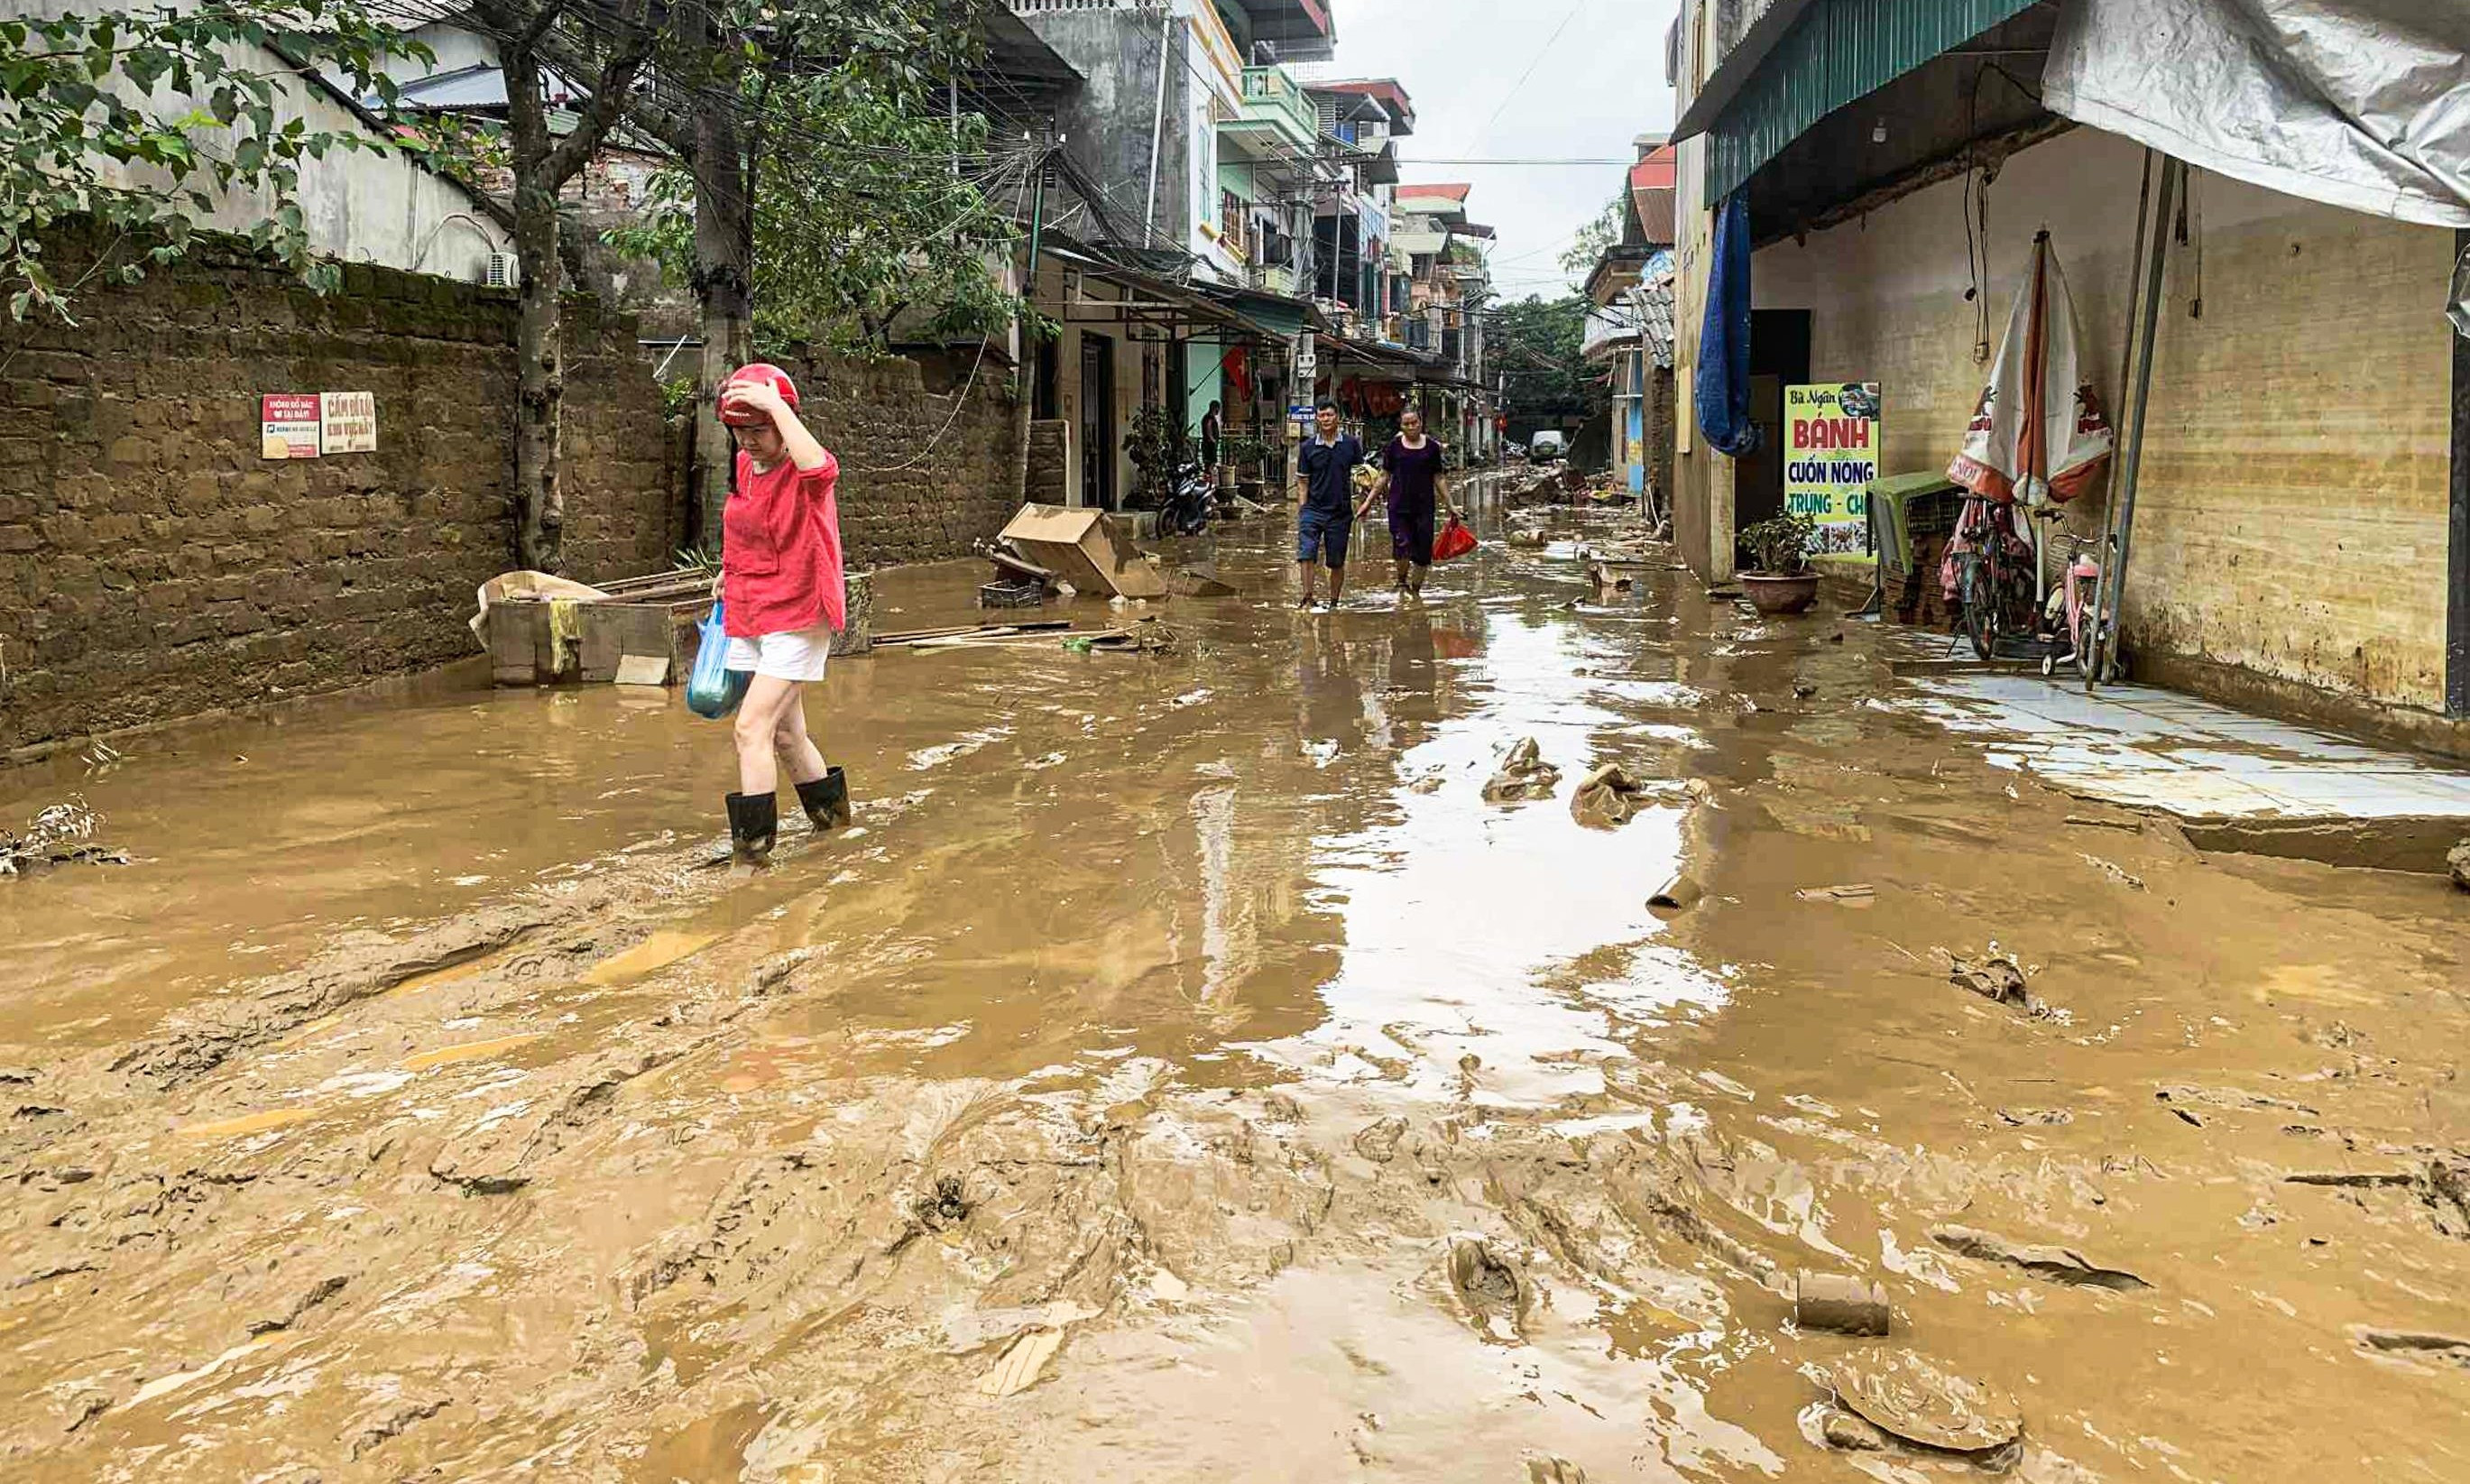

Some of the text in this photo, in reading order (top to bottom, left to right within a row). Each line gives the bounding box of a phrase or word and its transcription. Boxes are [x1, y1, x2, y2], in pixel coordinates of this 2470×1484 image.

[1790, 389, 1836, 409] Bà Ngân
[1793, 411, 1870, 448] BÁNH
[1788, 454, 1875, 484] CUỐN NÓNG
[1847, 493, 1867, 515] CH
